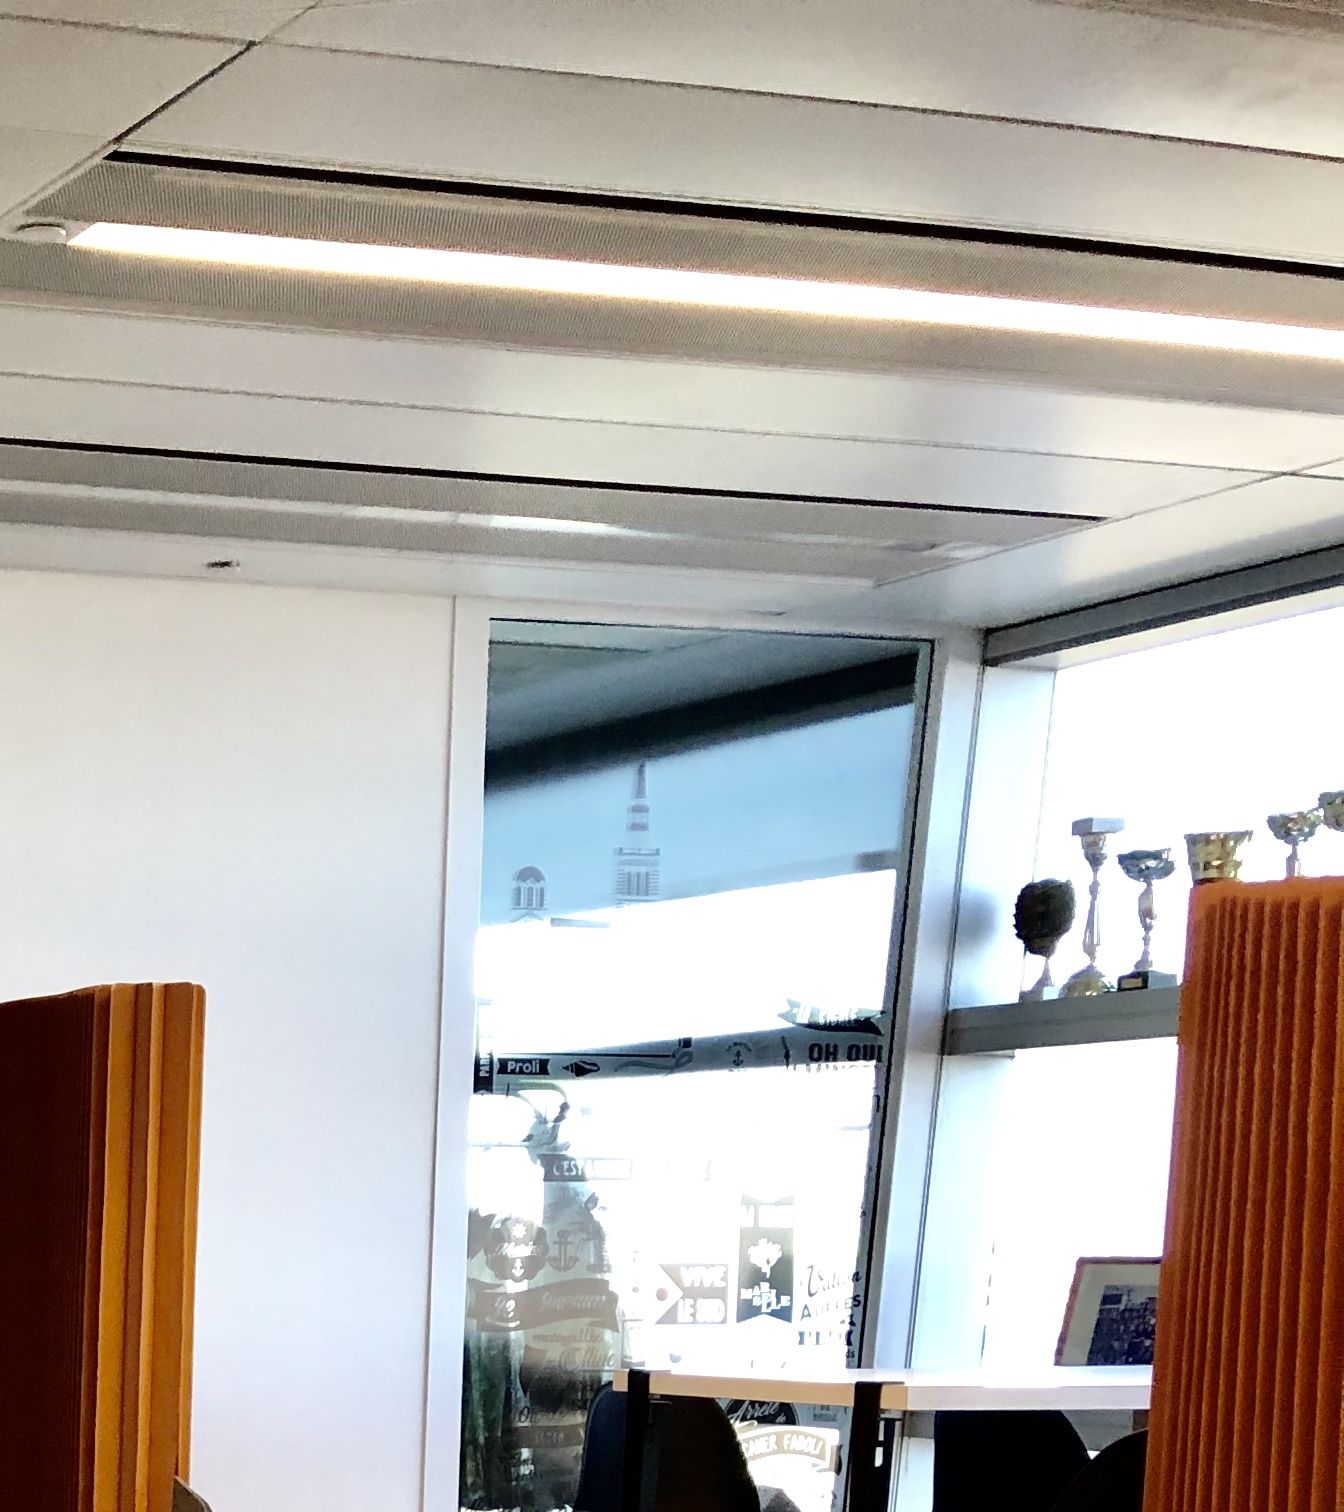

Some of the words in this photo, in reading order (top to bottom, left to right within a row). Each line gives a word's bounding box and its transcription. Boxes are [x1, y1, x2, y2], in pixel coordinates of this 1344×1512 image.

[808, 1043, 839, 1063] OH
[507, 1060, 540, 1074] Proli
[680, 1265, 728, 1288] VIVE
[677, 1298, 694, 1324] LE
